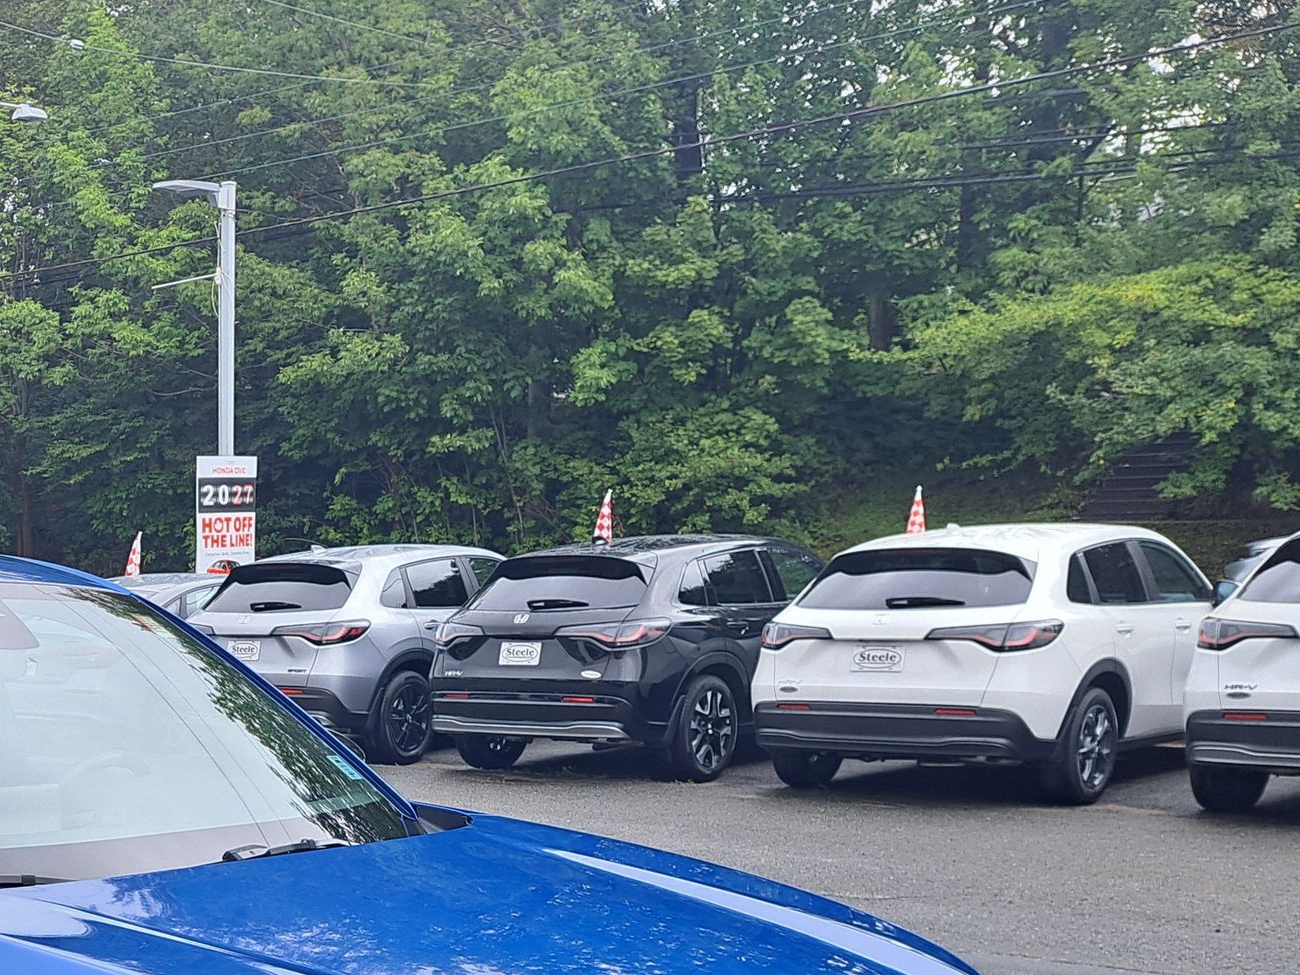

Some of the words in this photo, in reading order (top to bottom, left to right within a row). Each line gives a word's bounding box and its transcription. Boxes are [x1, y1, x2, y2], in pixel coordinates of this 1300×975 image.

[202, 517, 232, 533] HOT
[234, 516, 253, 533] OFF
[203, 534, 228, 549] THE
[230, 533, 253, 548] LINE!
[506, 648, 535, 657] Steele
[858, 652, 897, 662] Steele
